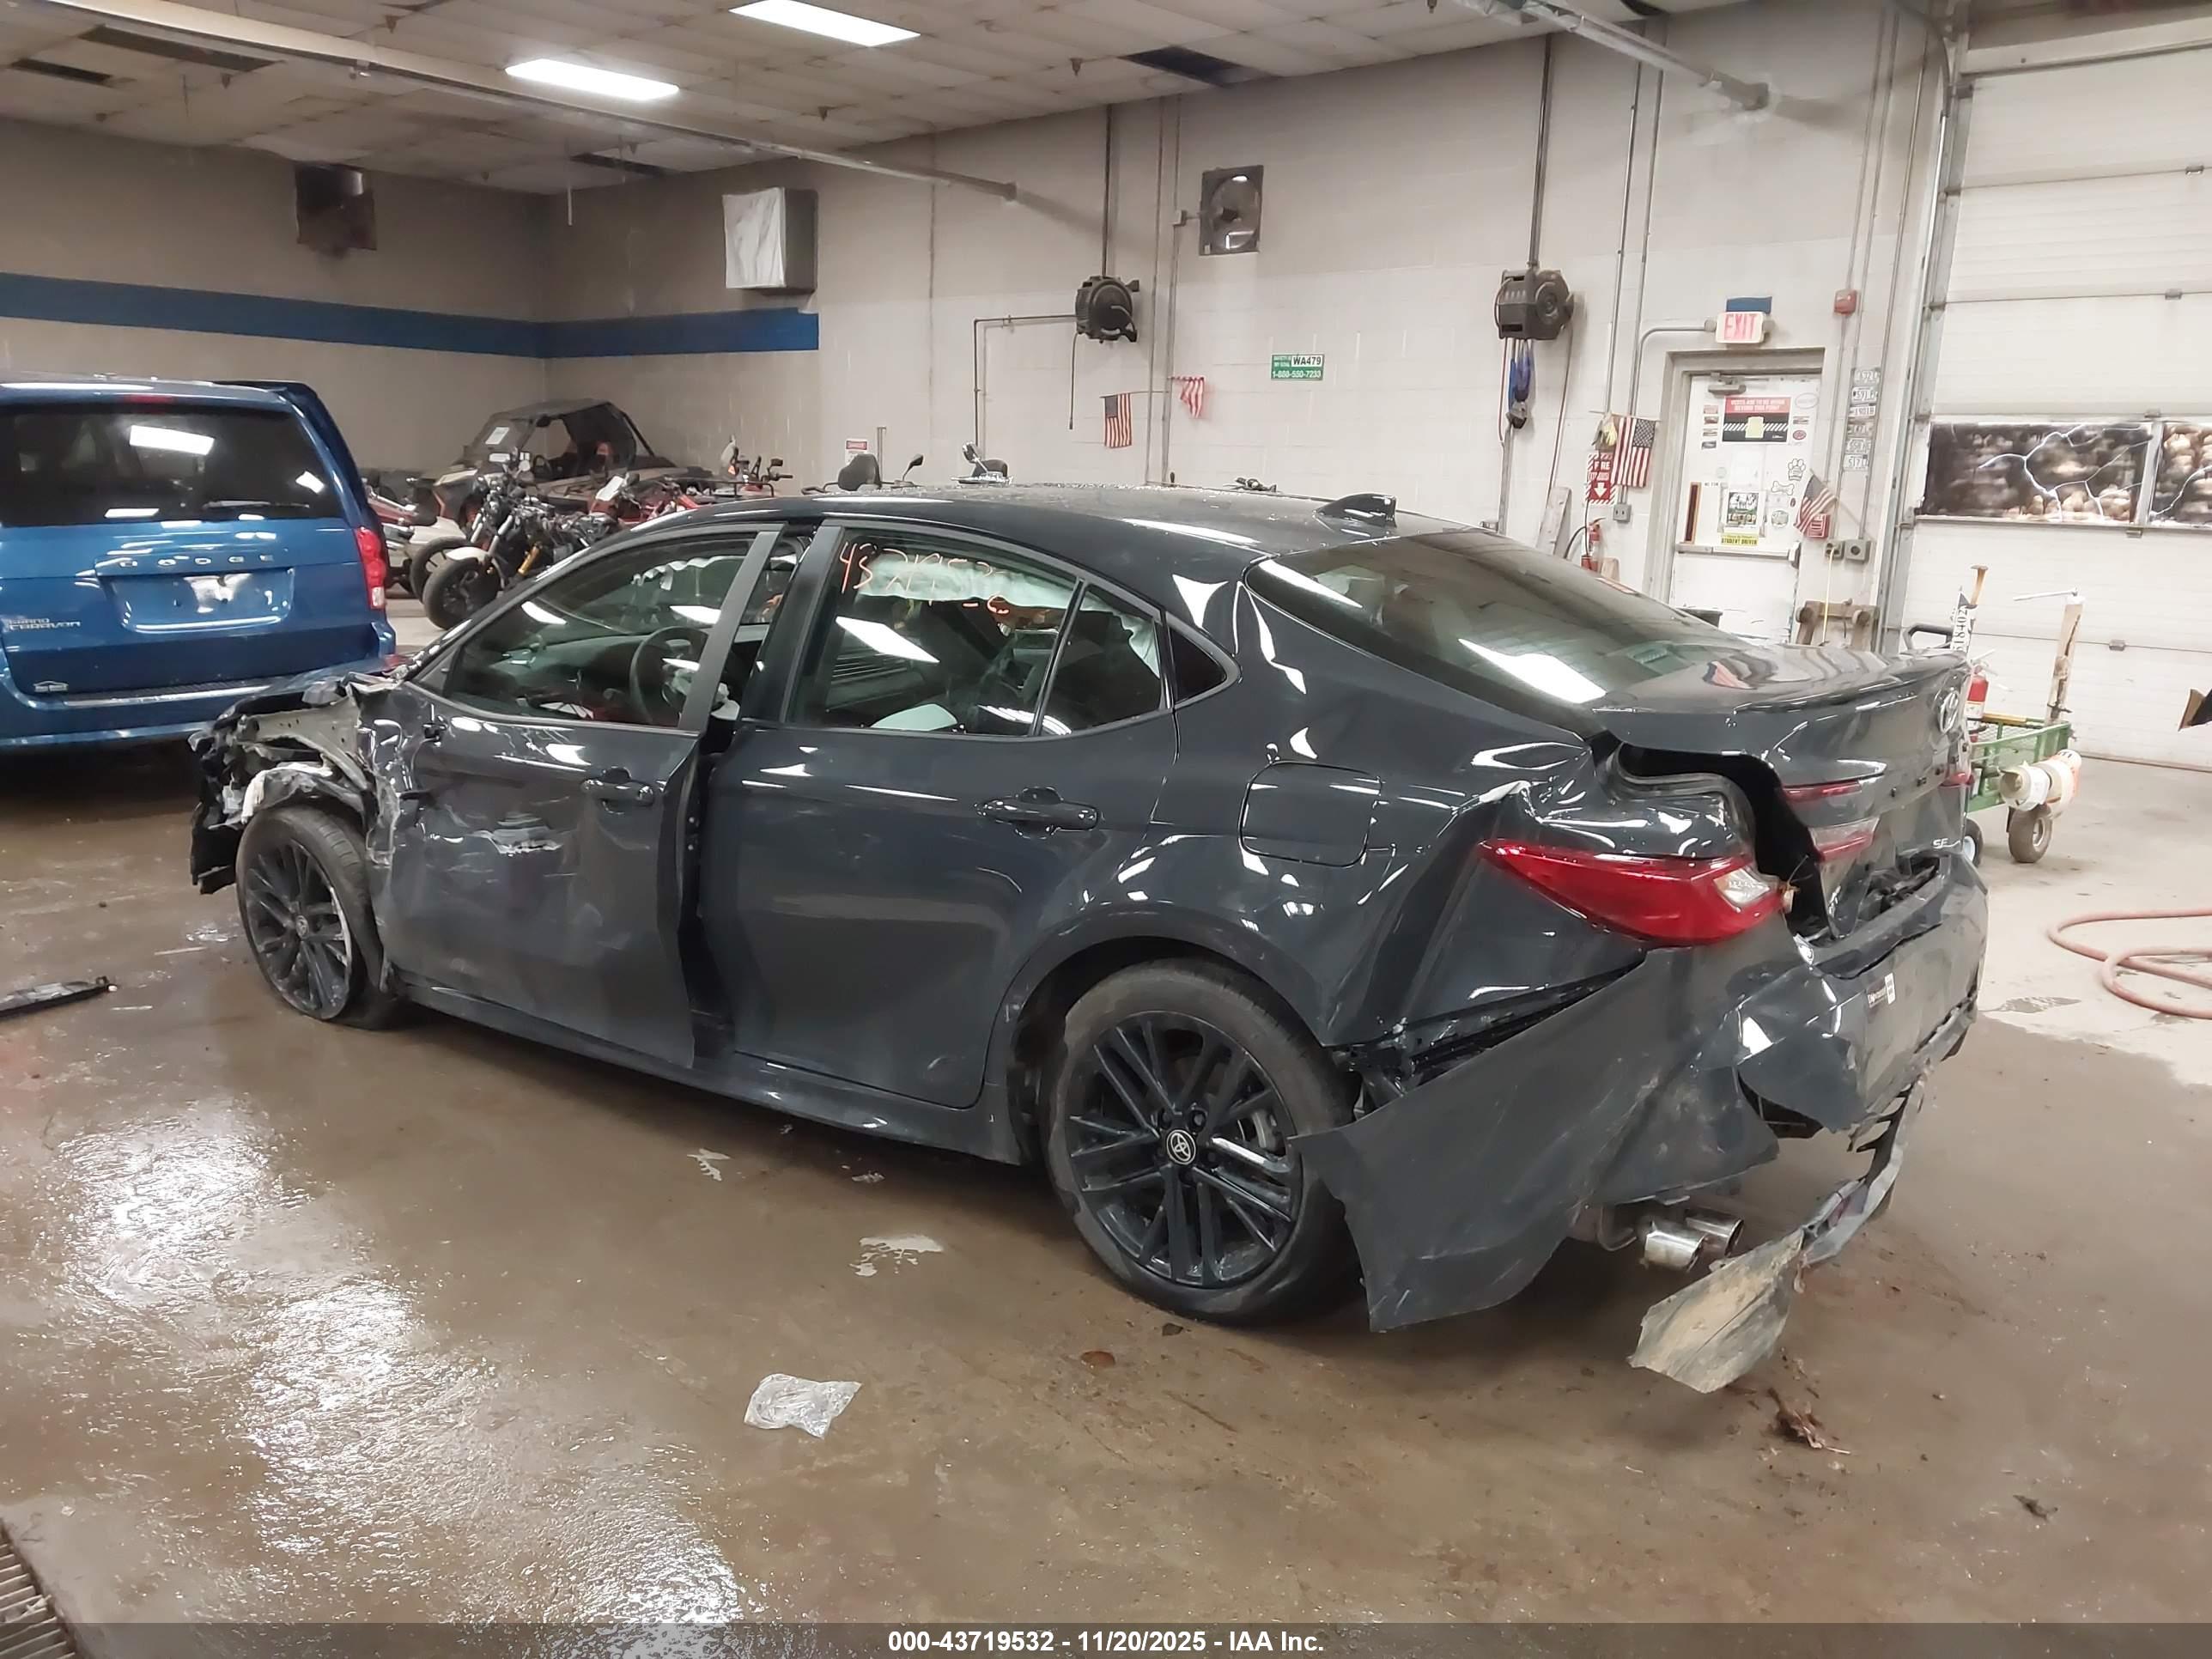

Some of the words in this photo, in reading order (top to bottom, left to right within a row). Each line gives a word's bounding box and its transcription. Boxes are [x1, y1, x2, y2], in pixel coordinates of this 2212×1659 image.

[1724, 313, 1757, 340] EXIT
[1293, 356, 1322, 365] WA479
[1594, 461, 1611, 471] FRE
[119, 554, 274, 568] DODGE
[1933, 837, 1949, 848] SE
